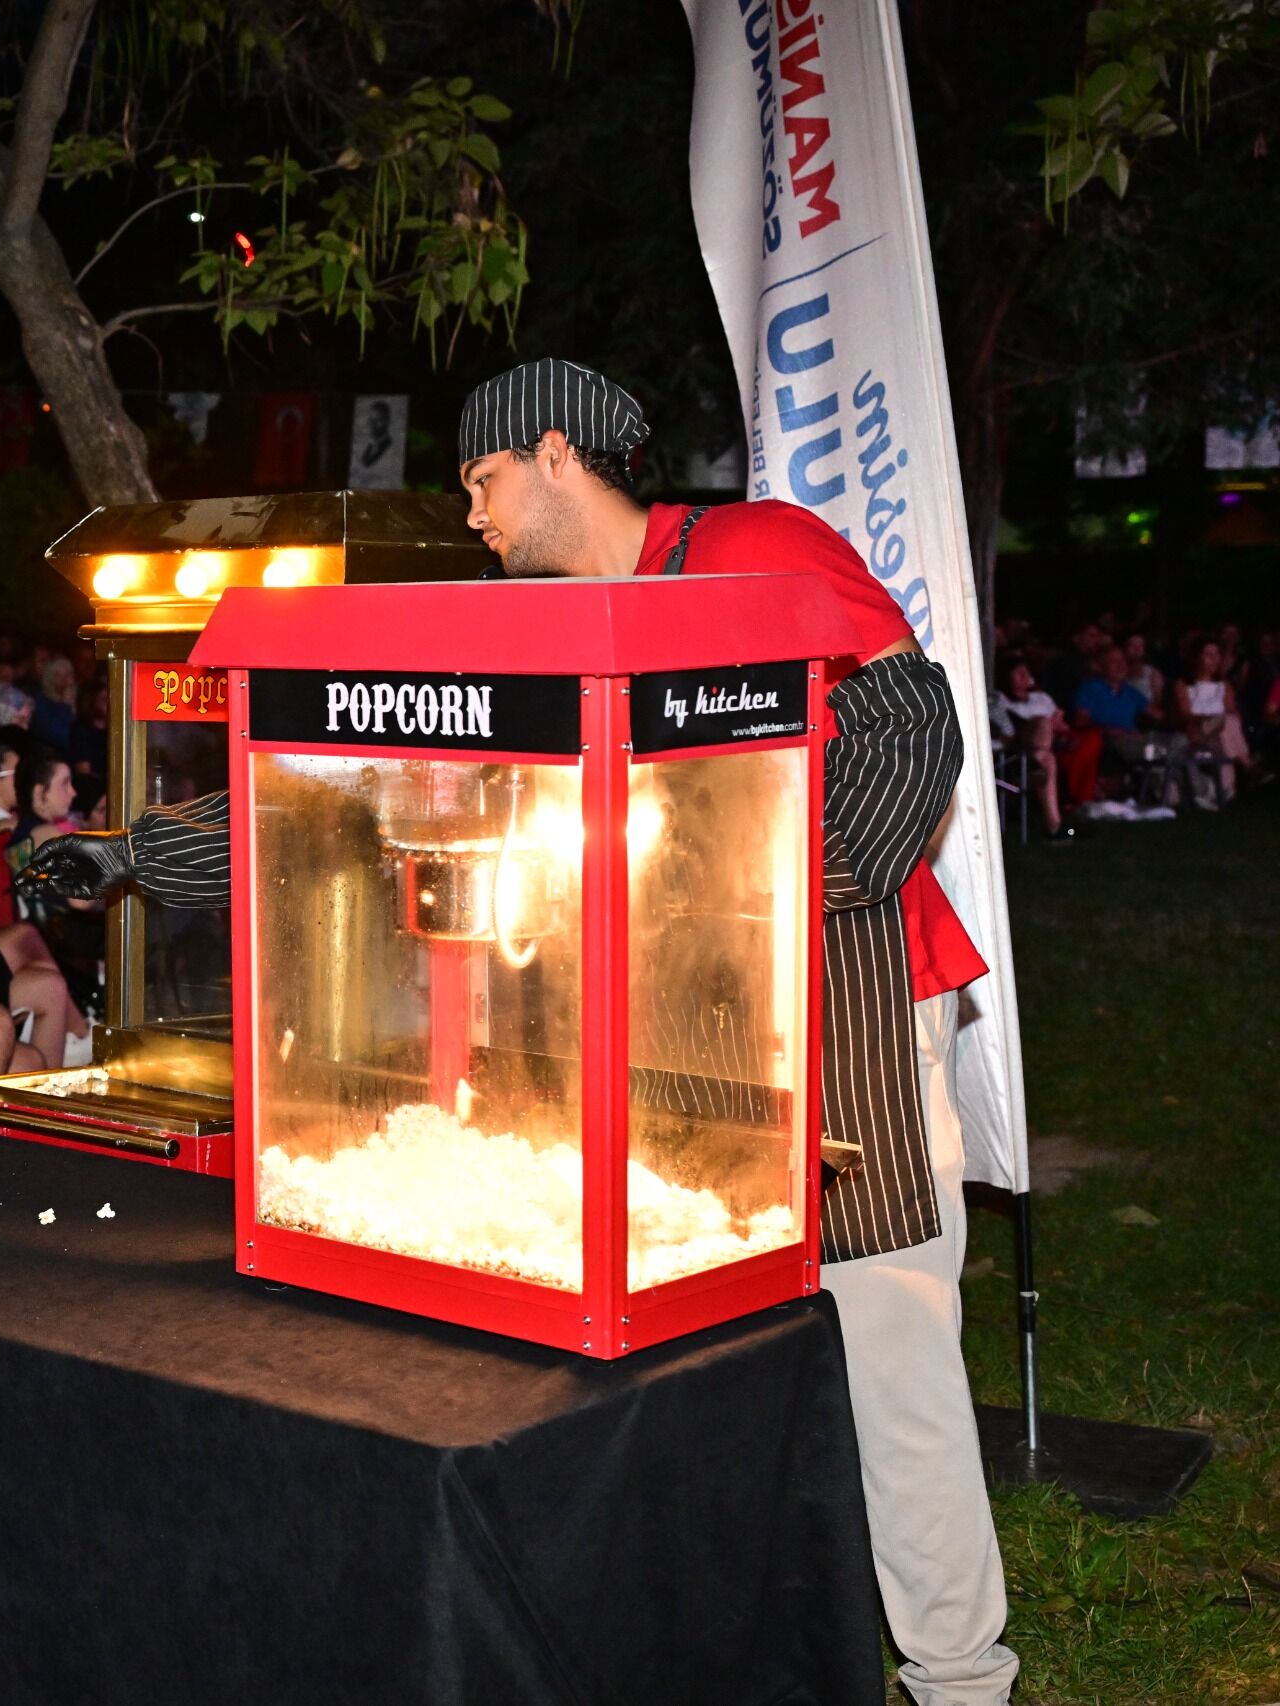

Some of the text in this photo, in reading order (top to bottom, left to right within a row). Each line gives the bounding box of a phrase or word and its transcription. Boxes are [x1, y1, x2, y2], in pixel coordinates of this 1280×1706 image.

[325, 682, 494, 738] POPCORN
[663, 682, 779, 728] by kitchen
[731, 720, 804, 737] www.bykitchen.com.tr
